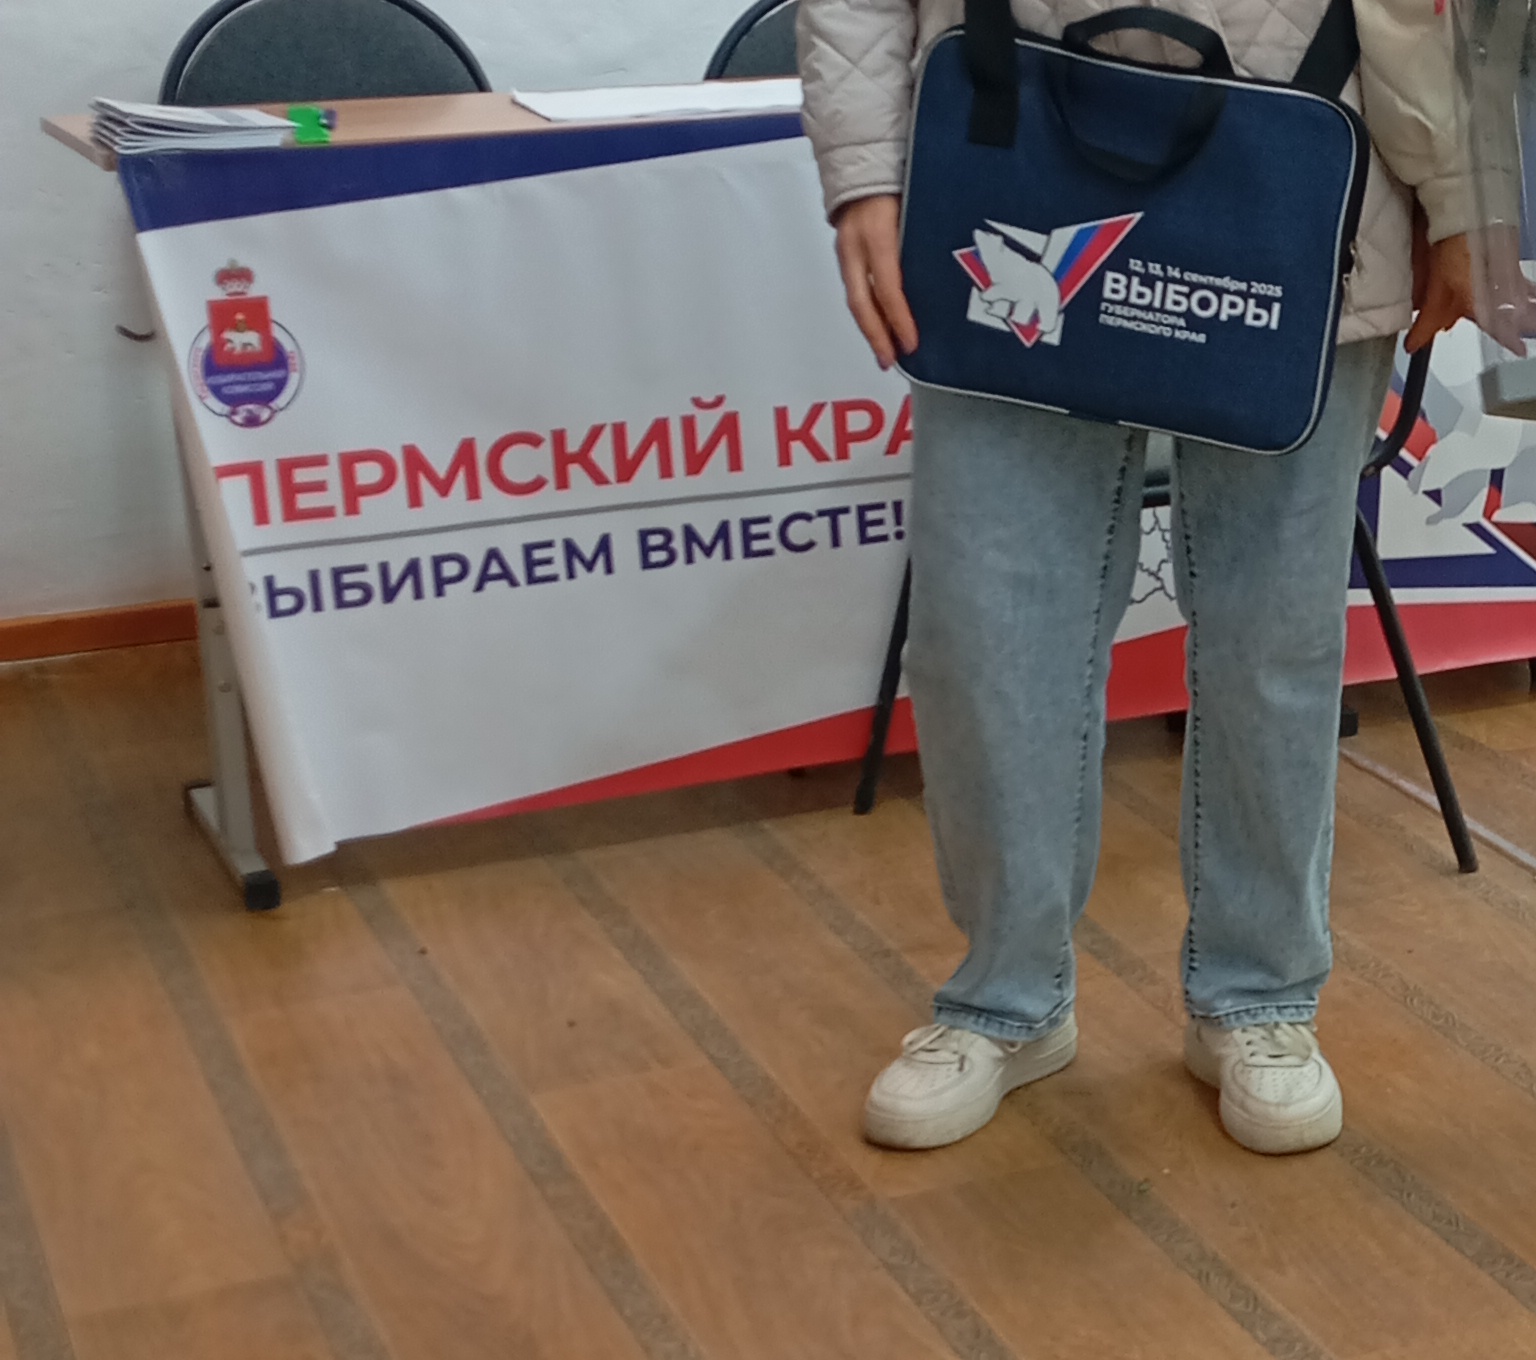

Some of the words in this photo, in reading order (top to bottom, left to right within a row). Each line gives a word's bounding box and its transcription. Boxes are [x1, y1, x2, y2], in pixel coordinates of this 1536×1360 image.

[1102, 270, 1281, 330] ВЫБОРЫ
[1128, 258, 1146, 274] 12,
[1183, 271, 1247, 292] сентября
[1250, 281, 1283, 297] 2025
[1099, 313, 1172, 337] ПЕРМСКОГО
[1174, 328, 1207, 343] КРАЯ
[1100, 302, 1186, 327] ГУБЕРНАТОРА
[213, 394, 744, 526] ПЕРМСКИЙ
[250, 533, 614, 619] ЫБИРАЕМ
[638, 500, 906, 570] ВМЕСТЕ!
